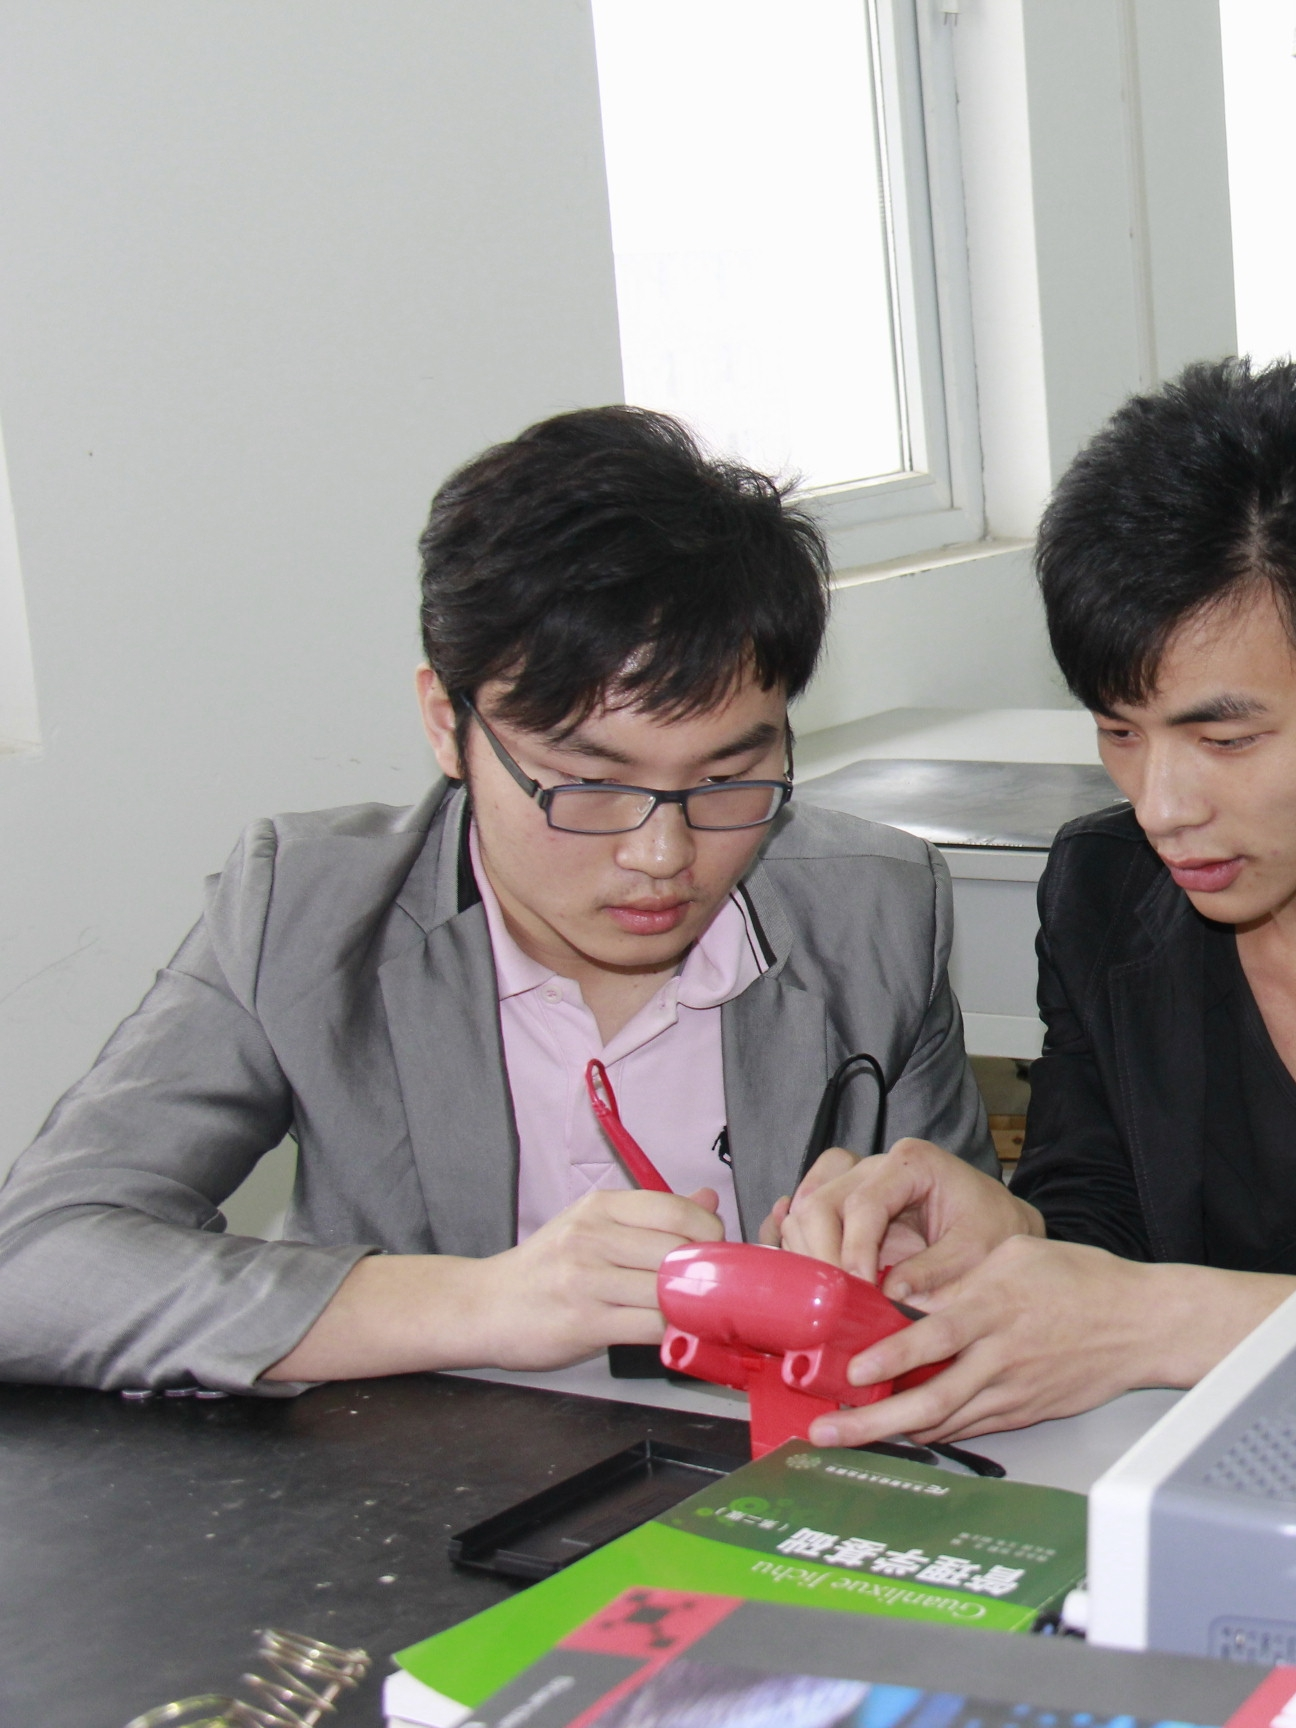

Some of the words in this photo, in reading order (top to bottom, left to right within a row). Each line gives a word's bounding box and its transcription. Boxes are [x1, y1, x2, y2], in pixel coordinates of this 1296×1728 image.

[776, 1527, 1025, 1597] 管理学基础
[831, 1577, 987, 1619] Guanlixue
